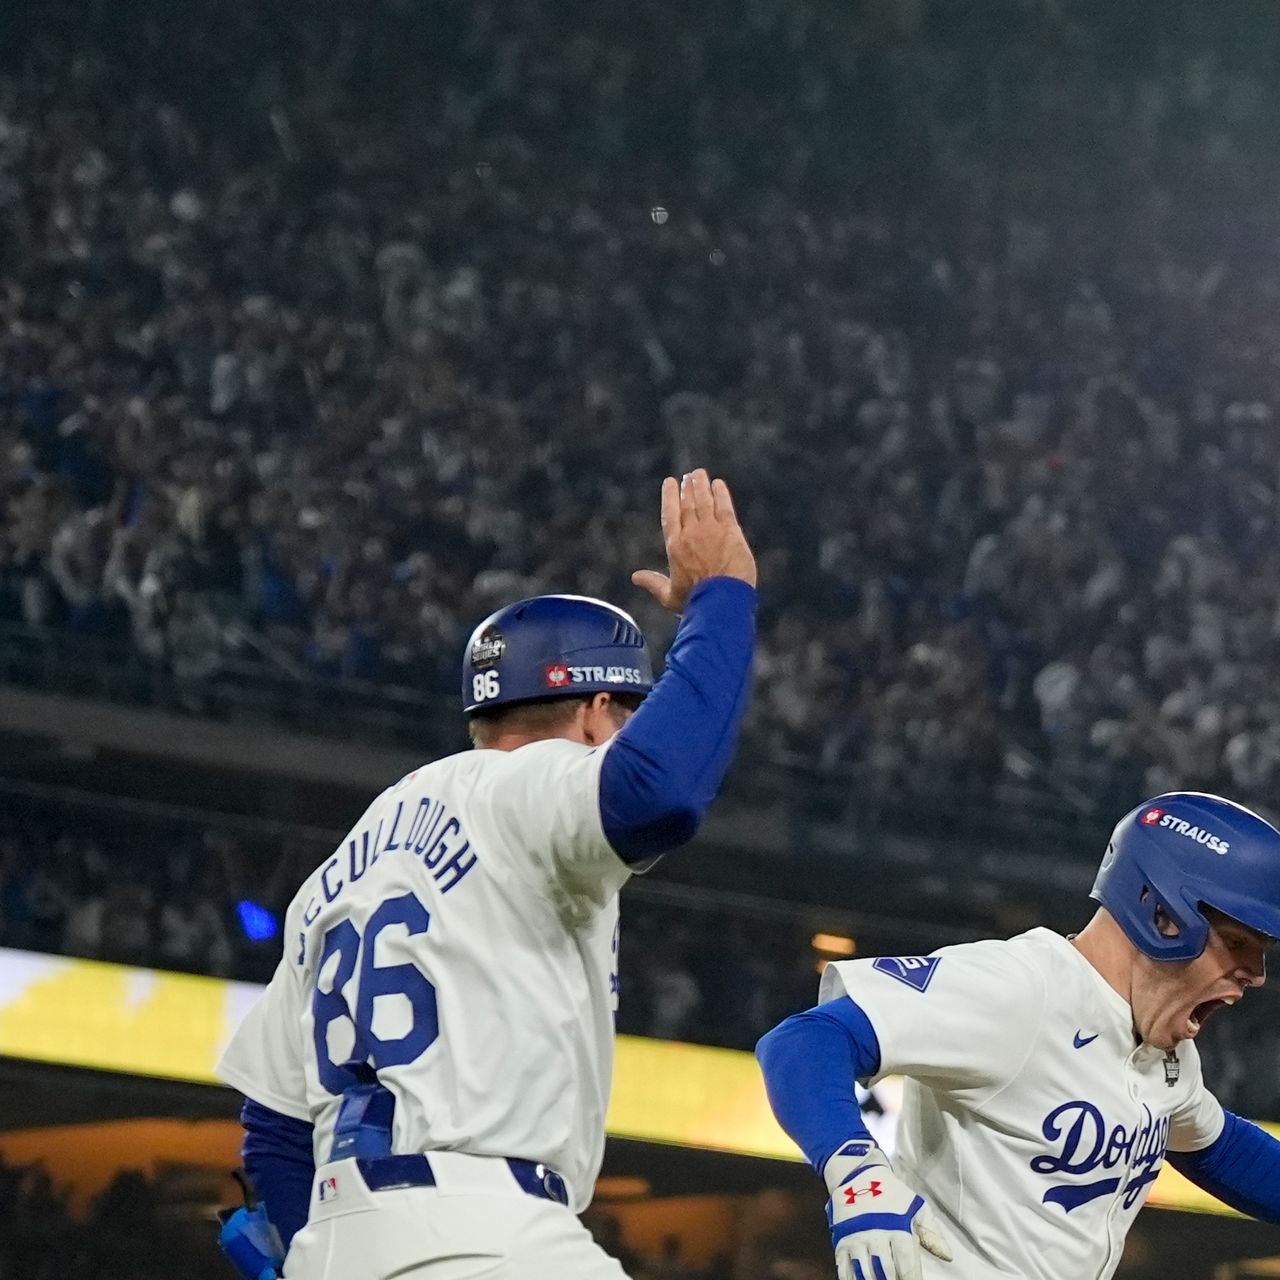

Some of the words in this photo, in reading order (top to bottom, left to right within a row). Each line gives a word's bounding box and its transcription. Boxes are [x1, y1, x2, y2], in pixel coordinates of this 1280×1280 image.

[472, 670, 501, 702] 86
[570, 666, 642, 685] STRAUSS
[1159, 814, 1231, 856] STRAUSS
[312, 891, 439, 1096] 86
